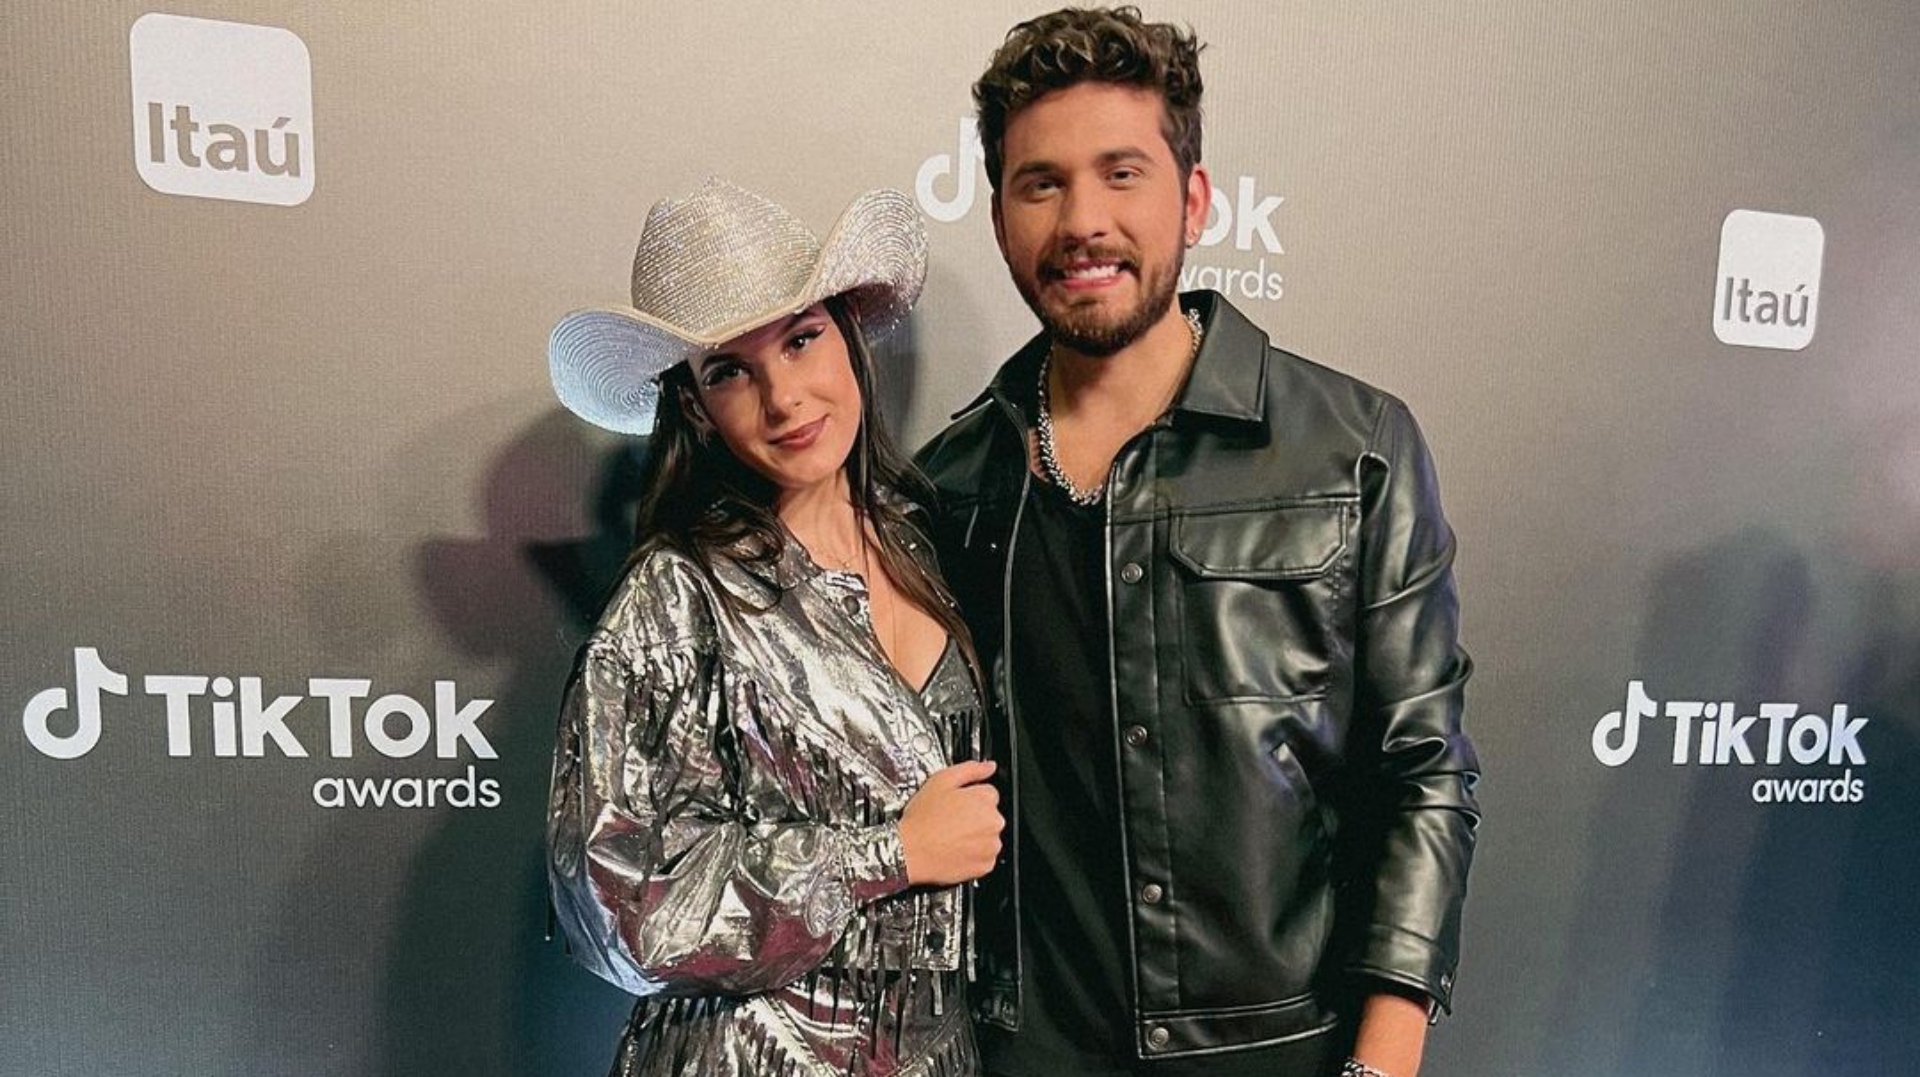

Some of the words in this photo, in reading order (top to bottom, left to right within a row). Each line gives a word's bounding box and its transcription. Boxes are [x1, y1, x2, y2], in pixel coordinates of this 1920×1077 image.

[147, 101, 301, 178] Itaú
[1177, 257, 1284, 300] wards
[1722, 276, 1809, 327] Itaú
[144, 674, 499, 759] TikTok
[1664, 700, 1870, 765] TikTok
[312, 765, 502, 808] awards
[1752, 768, 1864, 803] awards
